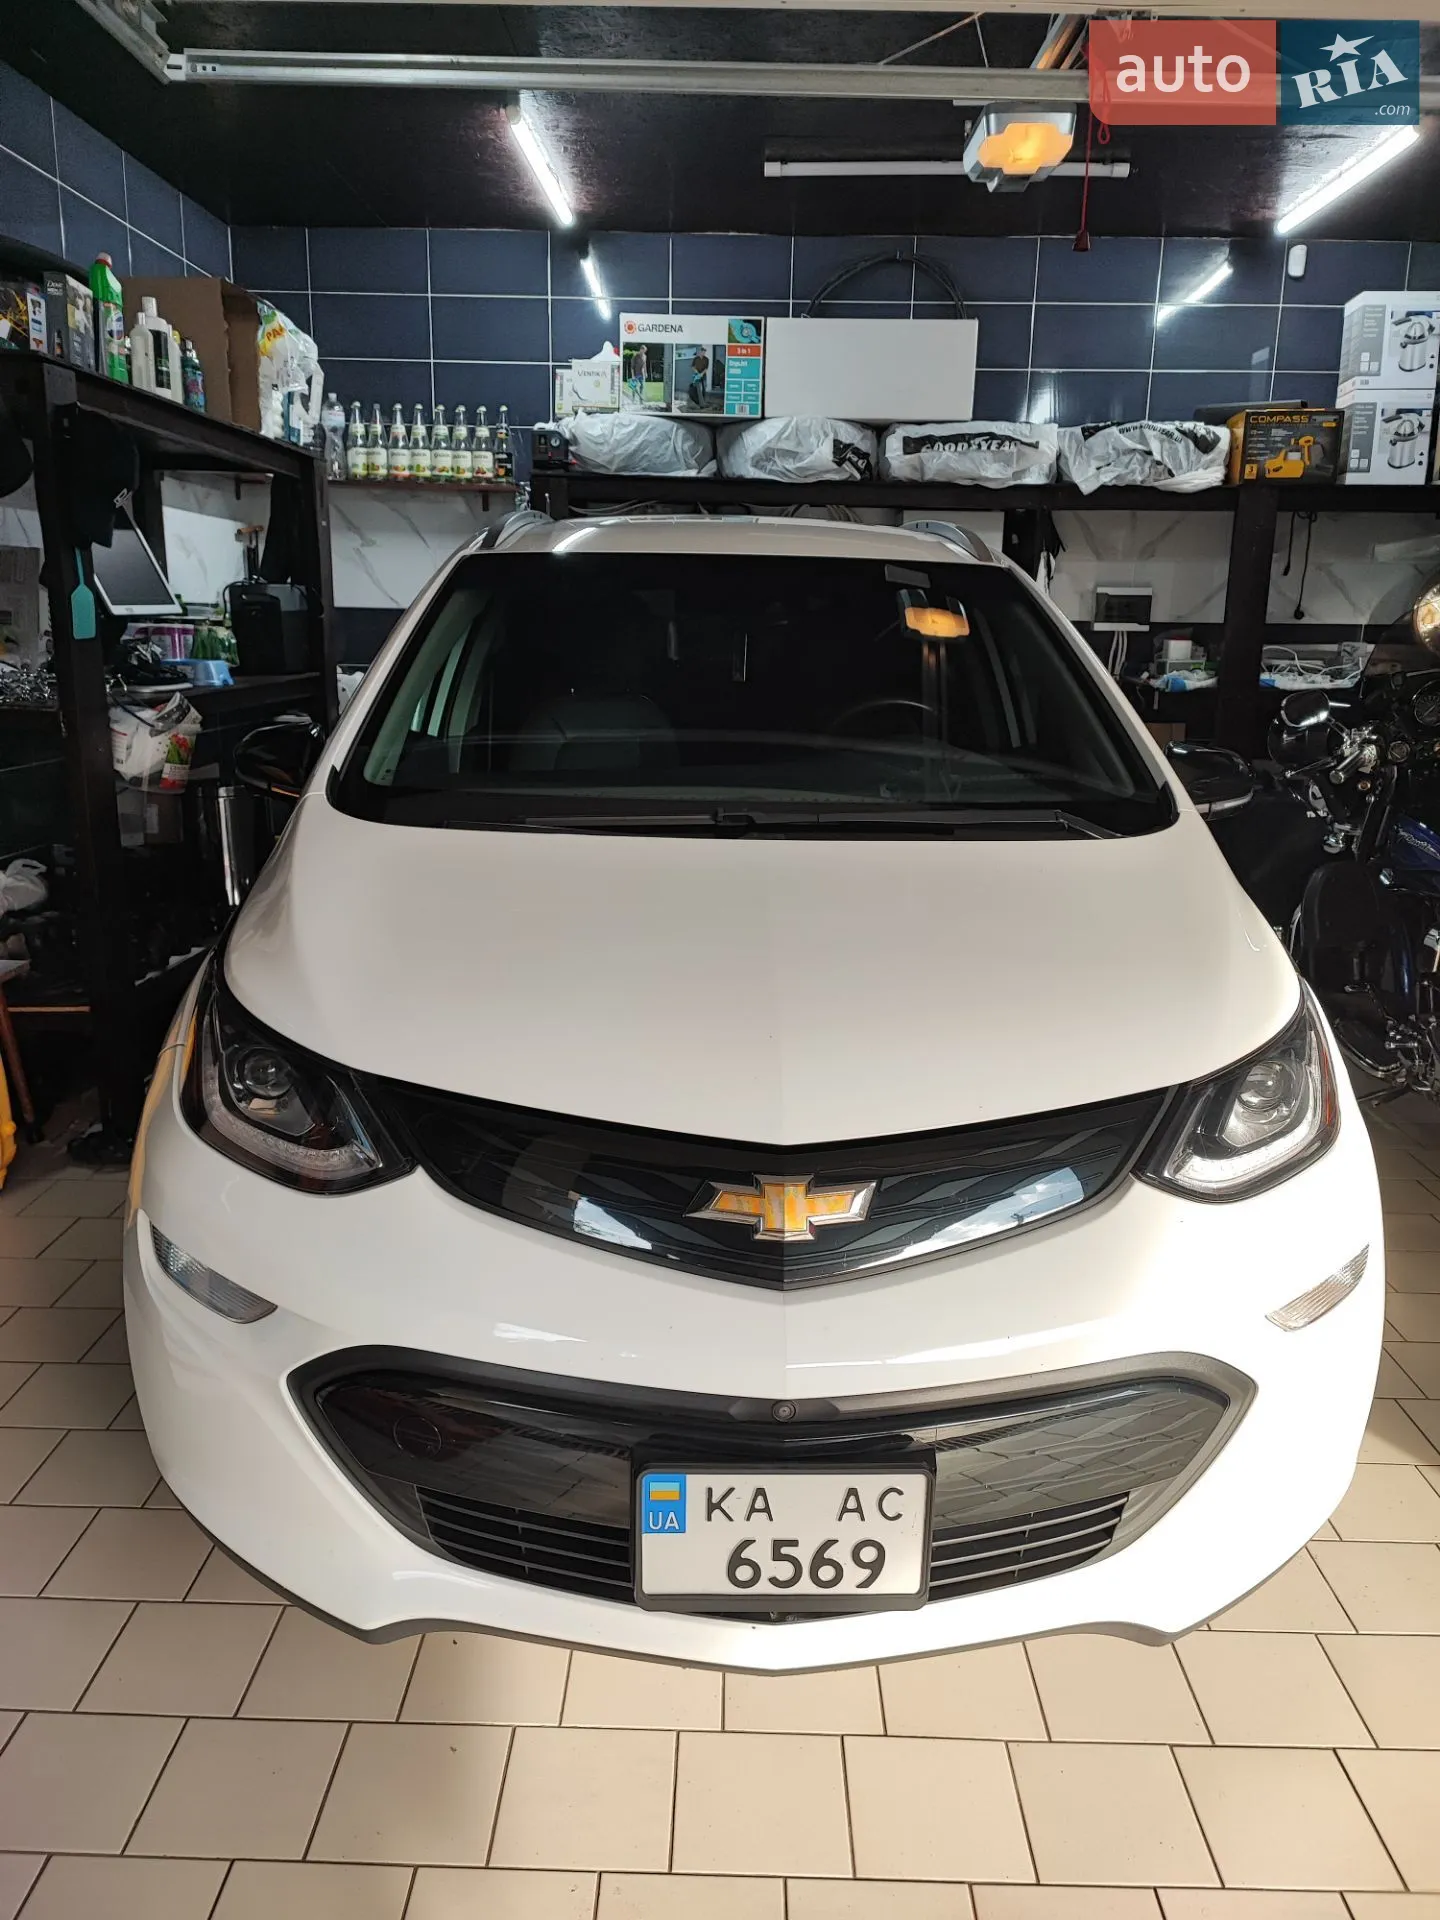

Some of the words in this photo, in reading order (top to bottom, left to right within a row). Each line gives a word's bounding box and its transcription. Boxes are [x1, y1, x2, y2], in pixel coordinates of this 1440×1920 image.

[637, 323, 684, 333] GARDENA
[1250, 415, 1309, 424] COMPASS
[1249, 465, 1254, 473] 3
[704, 1486, 774, 1522] KA
[837, 1486, 905, 1522] AC
[649, 1511, 680, 1531] UA
[726, 1539, 887, 1589] 6569
